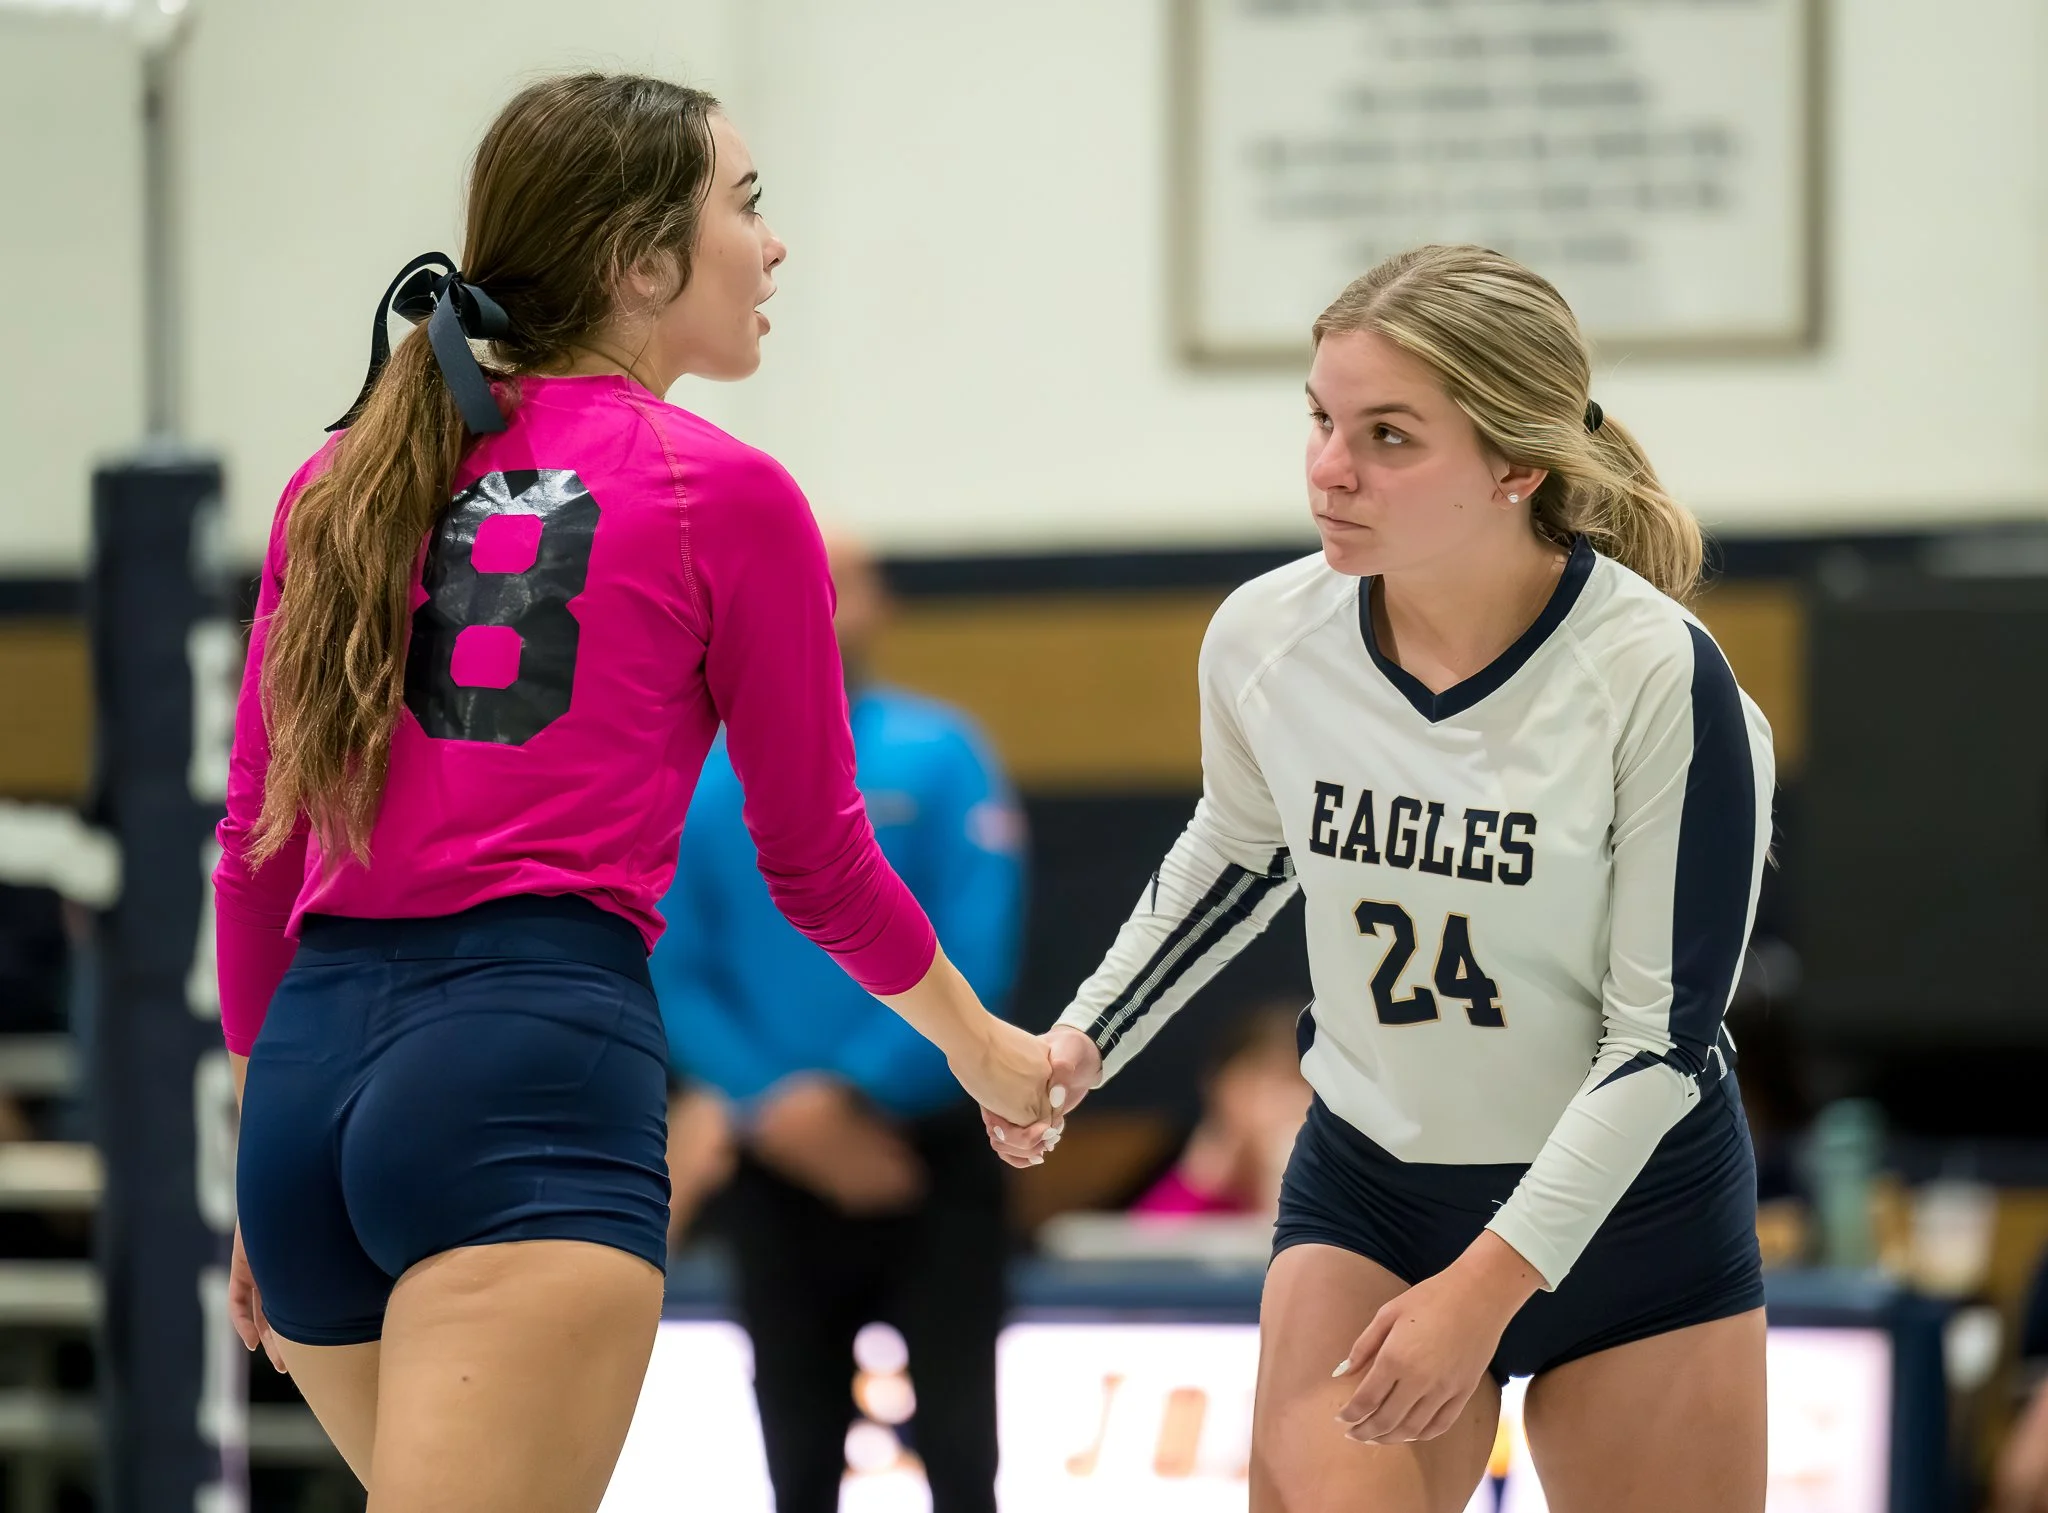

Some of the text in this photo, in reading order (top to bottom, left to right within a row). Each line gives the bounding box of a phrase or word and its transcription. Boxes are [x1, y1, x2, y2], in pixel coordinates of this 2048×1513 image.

[404, 468, 601, 746] 8
[1309, 780, 1537, 886] EAGLES
[1352, 897, 1508, 1029] 24
